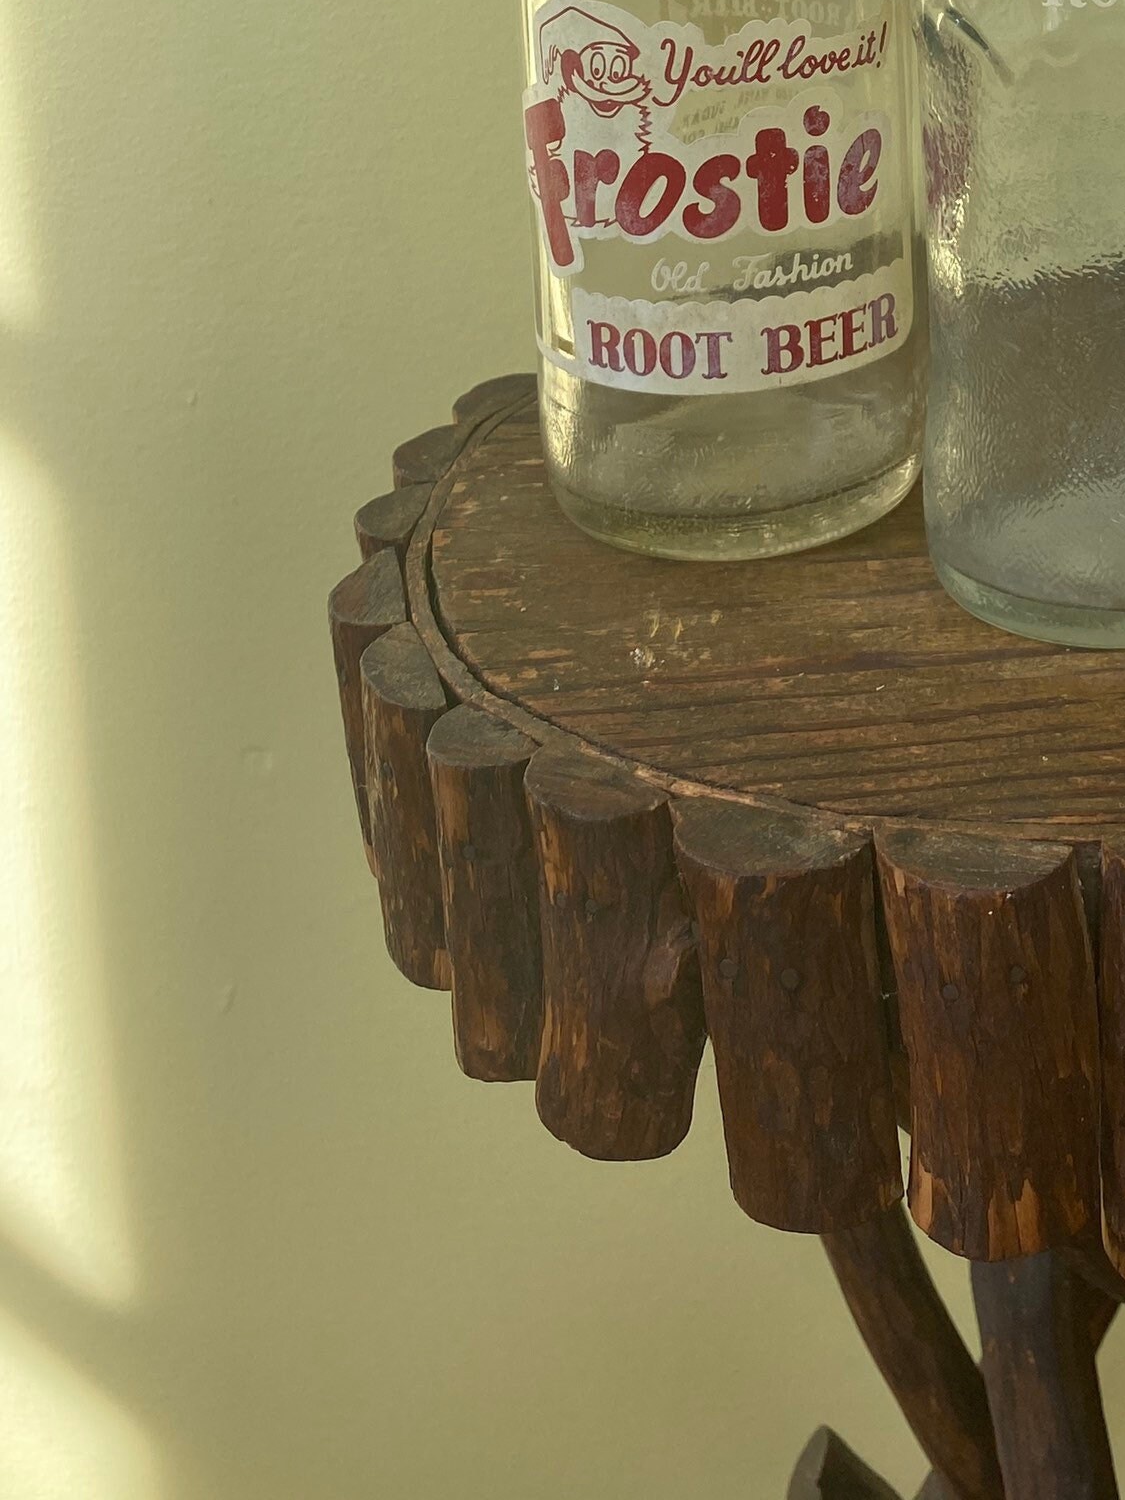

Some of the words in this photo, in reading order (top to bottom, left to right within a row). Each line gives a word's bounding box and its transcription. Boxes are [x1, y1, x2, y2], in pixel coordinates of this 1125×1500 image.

[524, 95, 884, 268] Frostie
[652, 253, 708, 294] Old
[733, 250, 853, 292] Fashion
[587, 317, 733, 380] ROOT
[760, 291, 899, 375] BEER
